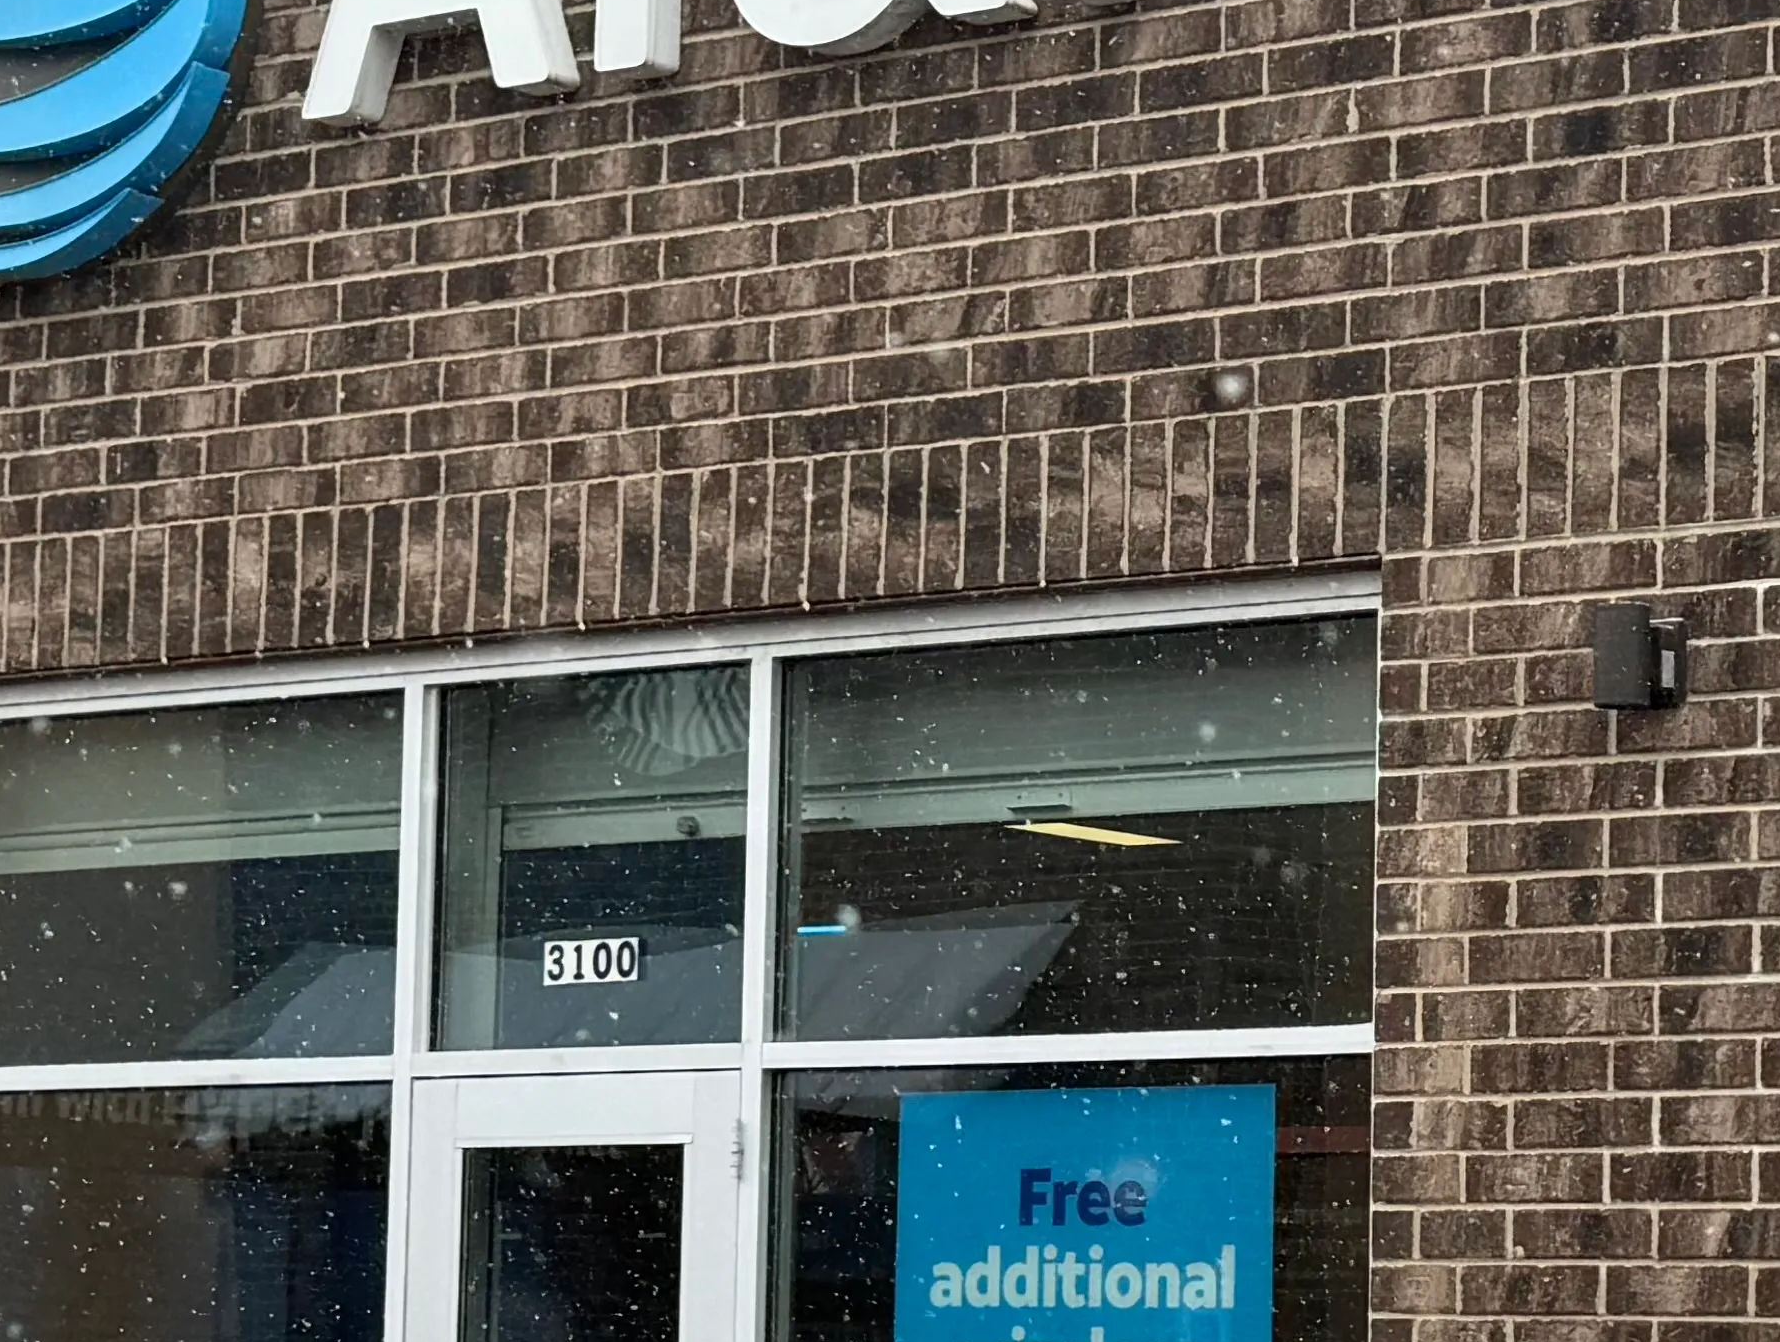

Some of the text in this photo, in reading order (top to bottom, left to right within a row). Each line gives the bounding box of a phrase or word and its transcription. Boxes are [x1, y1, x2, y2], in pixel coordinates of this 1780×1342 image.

[547, 941, 637, 981] 3100
[1018, 1167, 1148, 1227] Free
[929, 1243, 1237, 1312] additional
